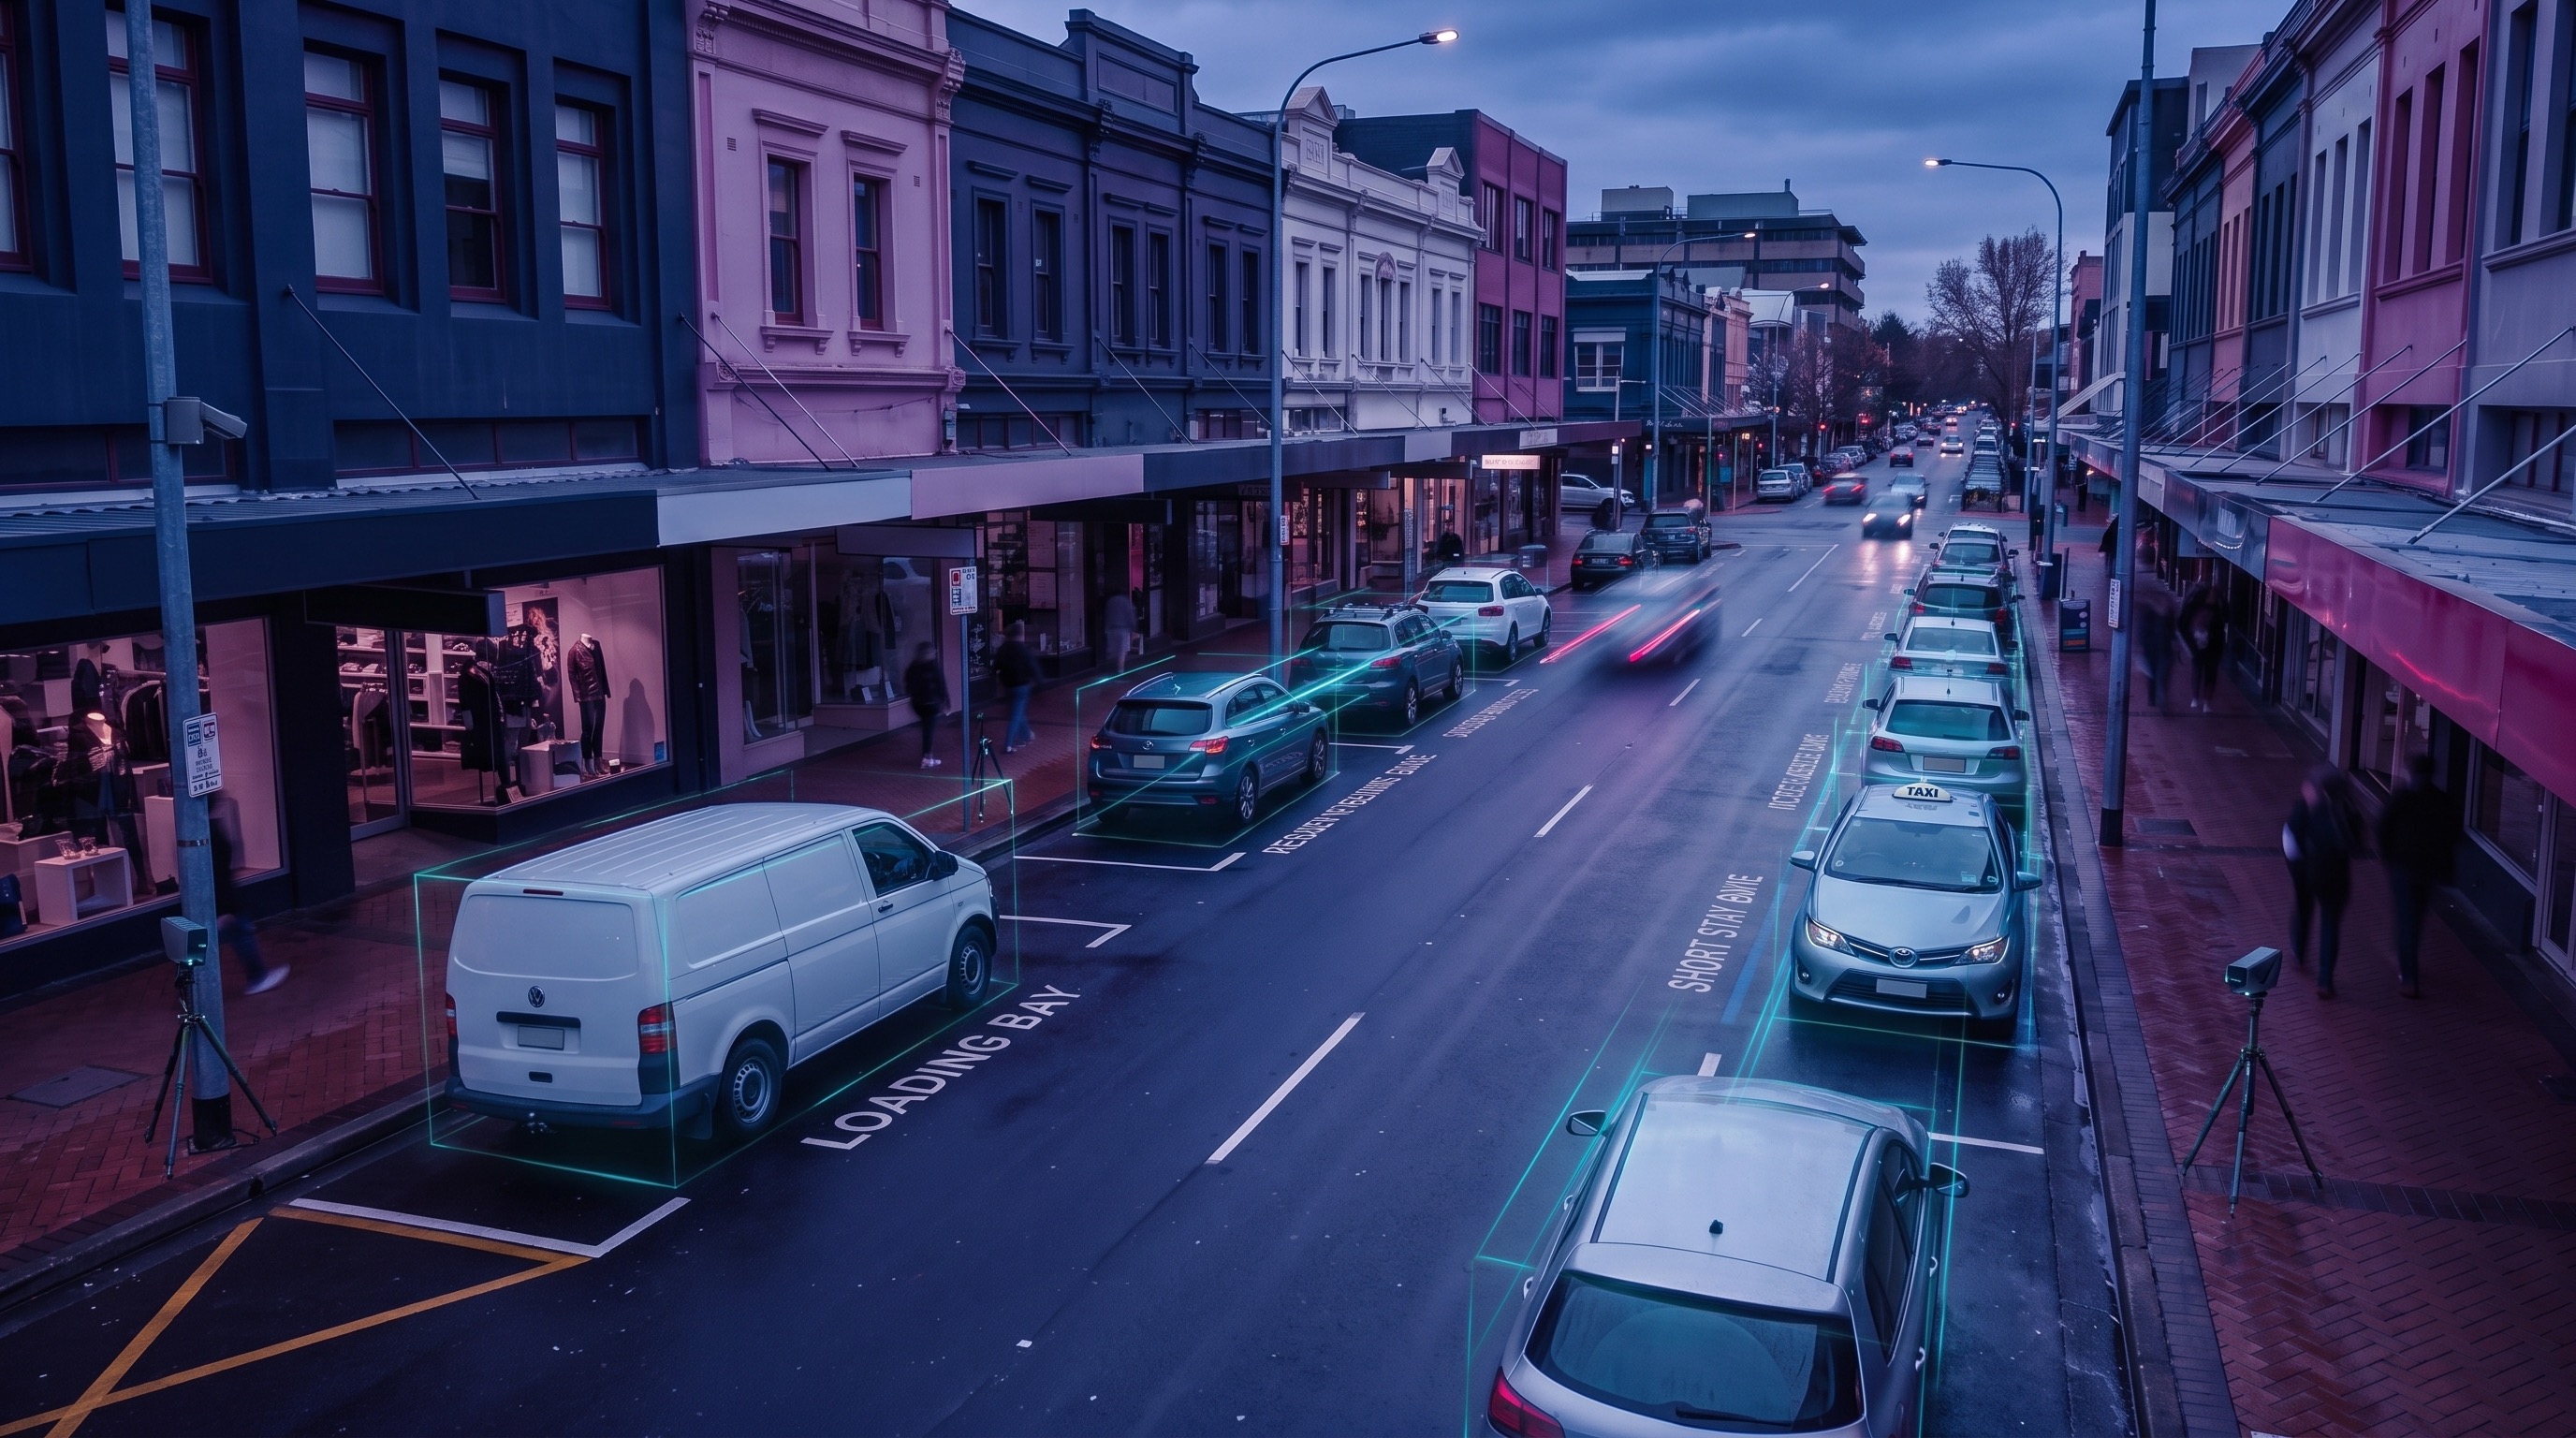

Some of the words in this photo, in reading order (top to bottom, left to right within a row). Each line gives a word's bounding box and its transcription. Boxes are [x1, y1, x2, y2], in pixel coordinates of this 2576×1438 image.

[1907, 786, 1939, 798] TAXI
[1697, 904, 1748, 938] STAY
[1667, 938, 1732, 992] SHORT
[800, 1034, 1011, 1150] LOADING
[986, 984, 1081, 1030] BAY
